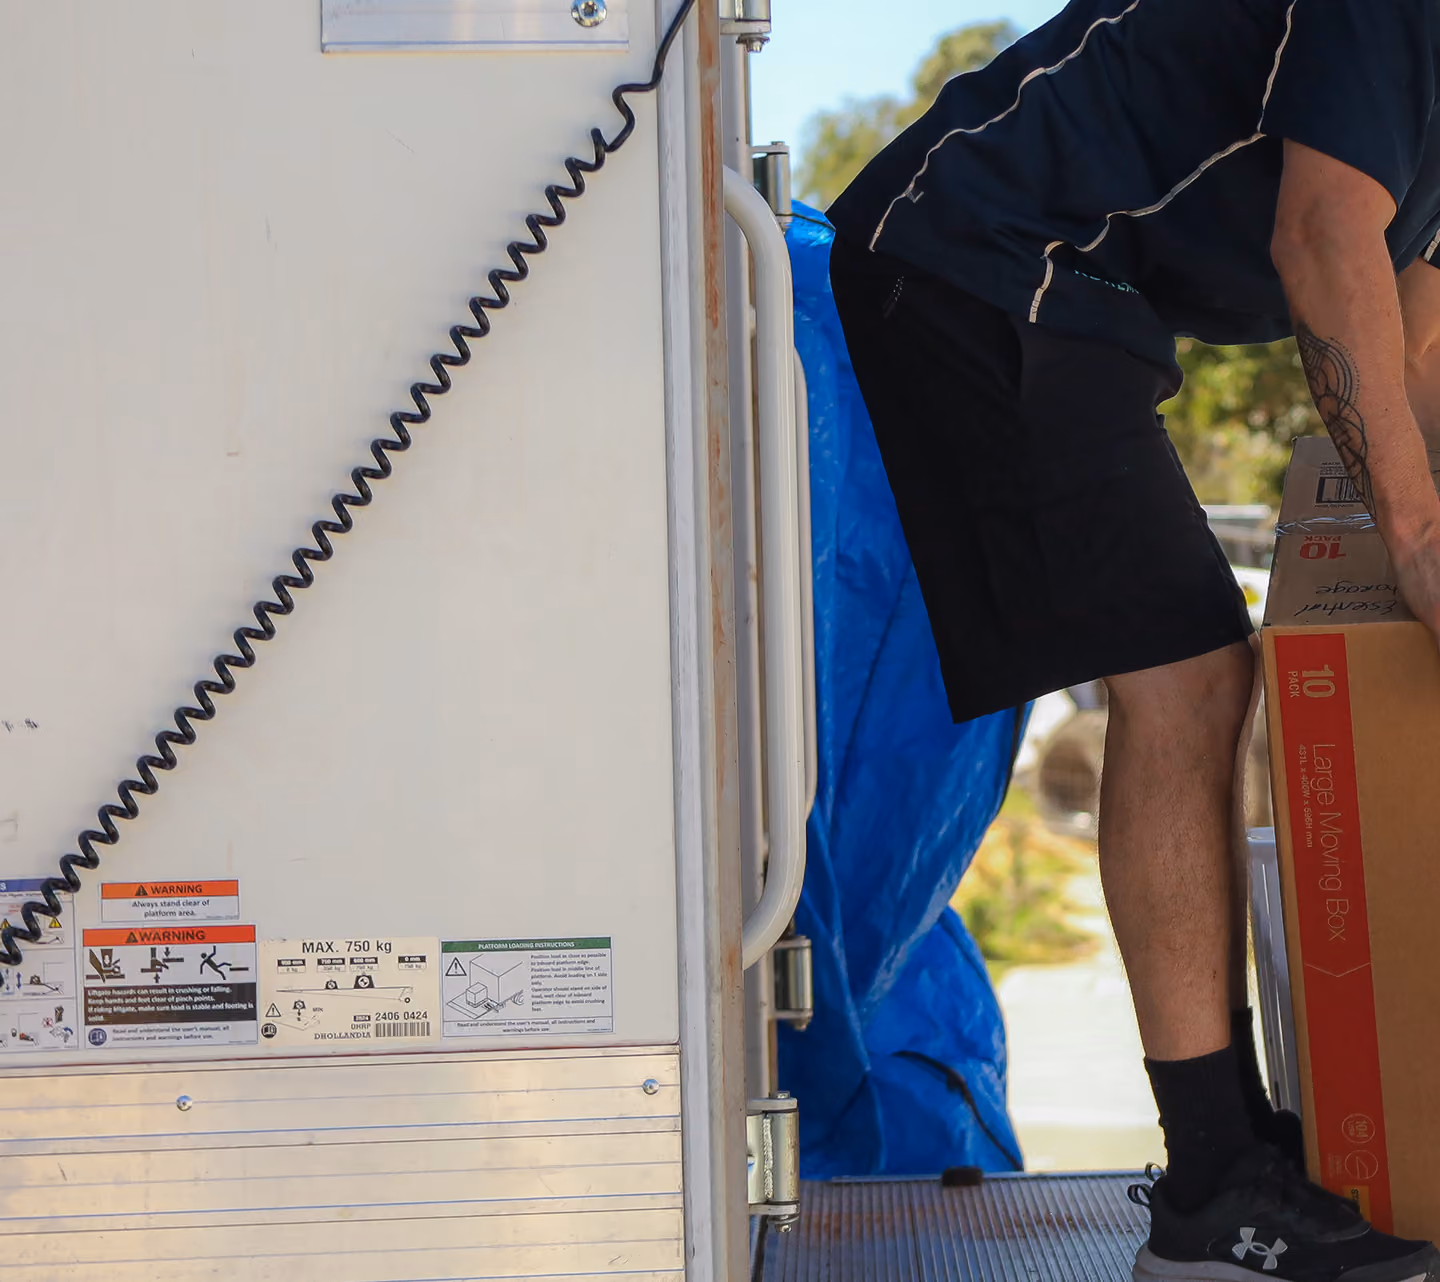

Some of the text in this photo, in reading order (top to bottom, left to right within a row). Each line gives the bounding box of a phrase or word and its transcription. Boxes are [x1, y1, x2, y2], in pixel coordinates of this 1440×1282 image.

[1300, 543, 1346, 559] 10
[1316, 580, 1400, 596] torage
[1288, 671, 1300, 698] PACK
[1301, 664, 1336, 698] 10
[1310, 744, 1350, 942] Large Moving Box
[150, 884, 203, 895] WARNING
[132, 898, 210, 908] Always stand clear of
[144, 910, 177, 919] platform
[178, 909, 197, 917] area.
[139, 929, 206, 943] WARNING
[302, 940, 392, 954] MAX. 750 kg
[375, 1012, 400, 1021] 2406
[403, 1011, 428, 1020] 0424
[314, 1031, 371, 1040] DHOLLANDIA
